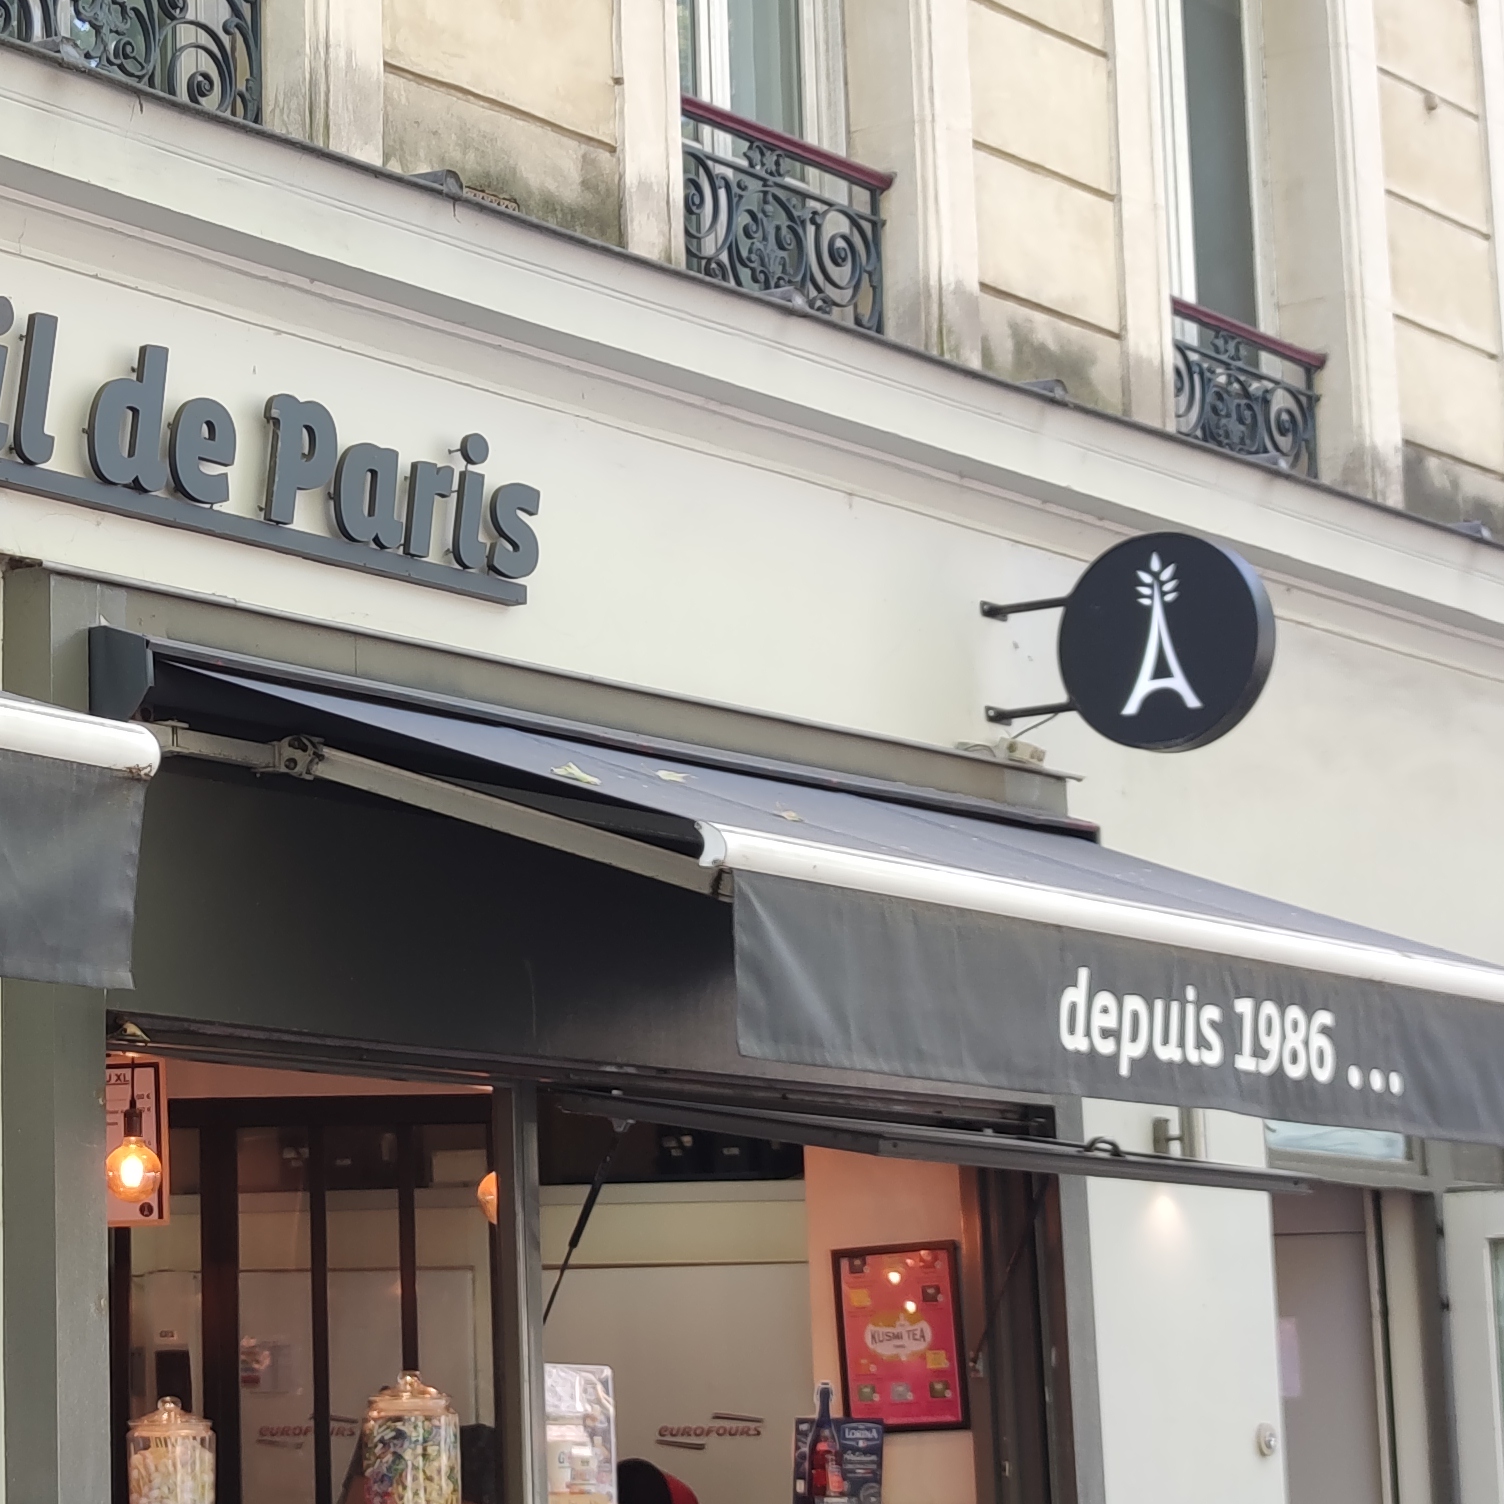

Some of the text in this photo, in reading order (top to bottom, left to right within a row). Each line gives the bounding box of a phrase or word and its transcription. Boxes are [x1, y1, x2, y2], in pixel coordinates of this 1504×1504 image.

[88, 344, 235, 506] de
[260, 392, 541, 582] Paris
[1059, 967, 1225, 1078] depuis
[1233, 997, 1338, 1084] 1986
[870, 1327, 927, 1346] KUSMI TEA
